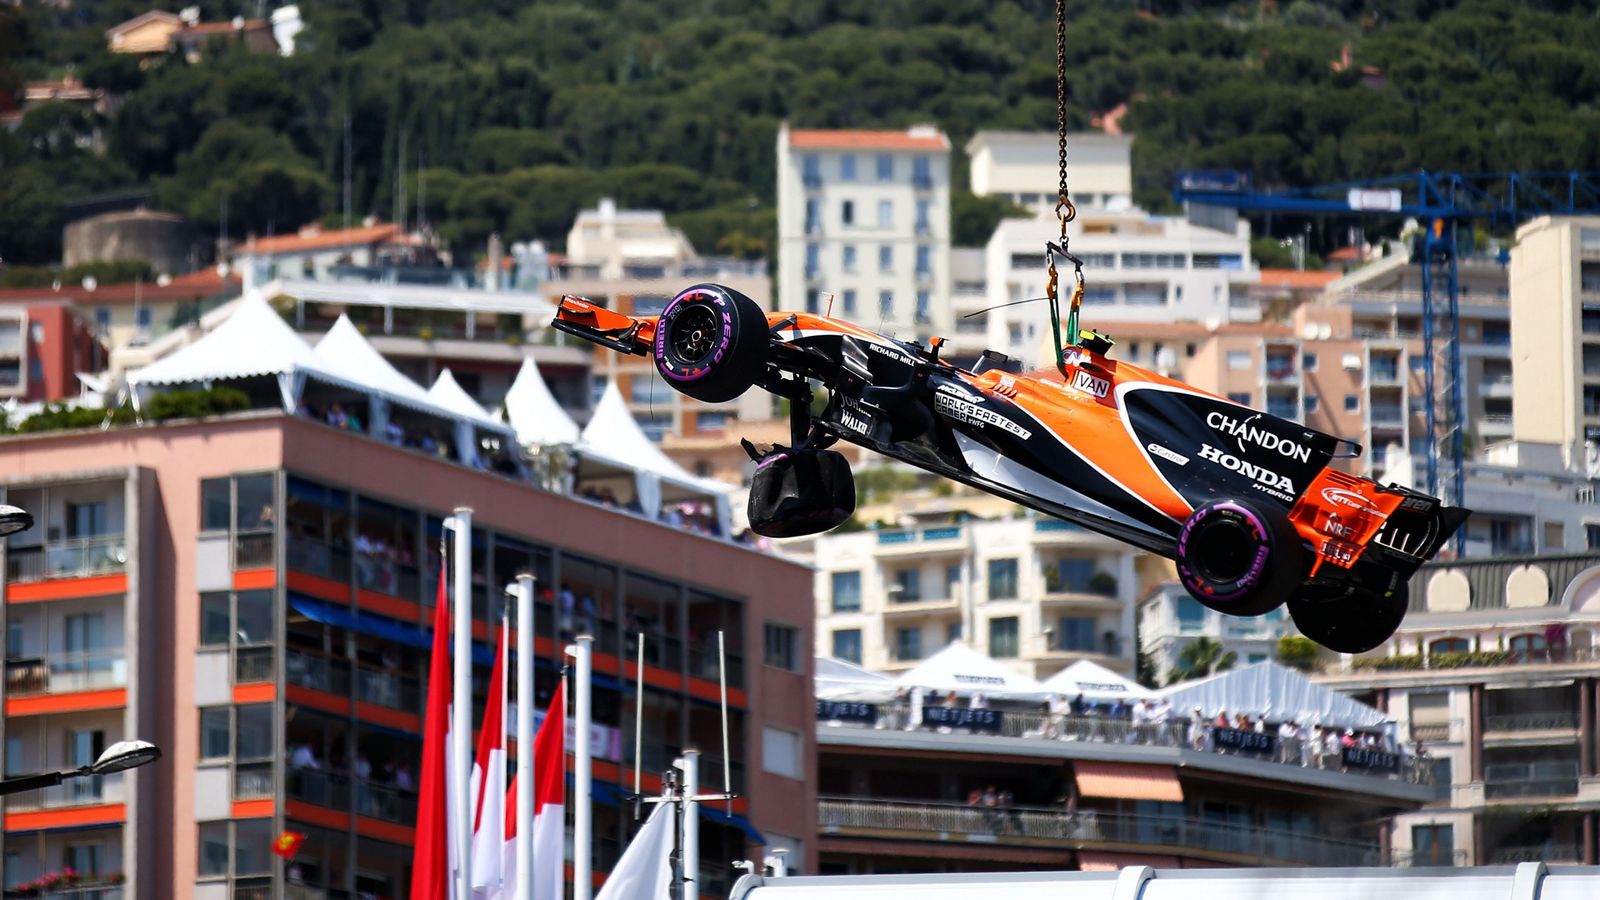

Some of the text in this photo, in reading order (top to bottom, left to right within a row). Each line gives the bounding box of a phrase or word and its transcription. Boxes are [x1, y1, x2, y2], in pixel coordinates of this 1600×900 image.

[656, 319, 666, 360] PIRELLI
[713, 312, 732, 364] ZERO
[869, 343, 899, 361] RICHARD
[1079, 374, 1109, 397] VAN
[936, 404, 968, 423] GAMER
[936, 393, 1029, 438] WORLD'S FASTEST
[1206, 411, 1312, 464] CHANDON
[1197, 442, 1296, 496] HONDA
[1253, 483, 1294, 503] HYBRID
[1178, 507, 1208, 558] ZERO
[1324, 519, 1353, 538] NRF
[927, 707, 994, 725] NETJETS
[1219, 729, 1269, 749] NETJETS
